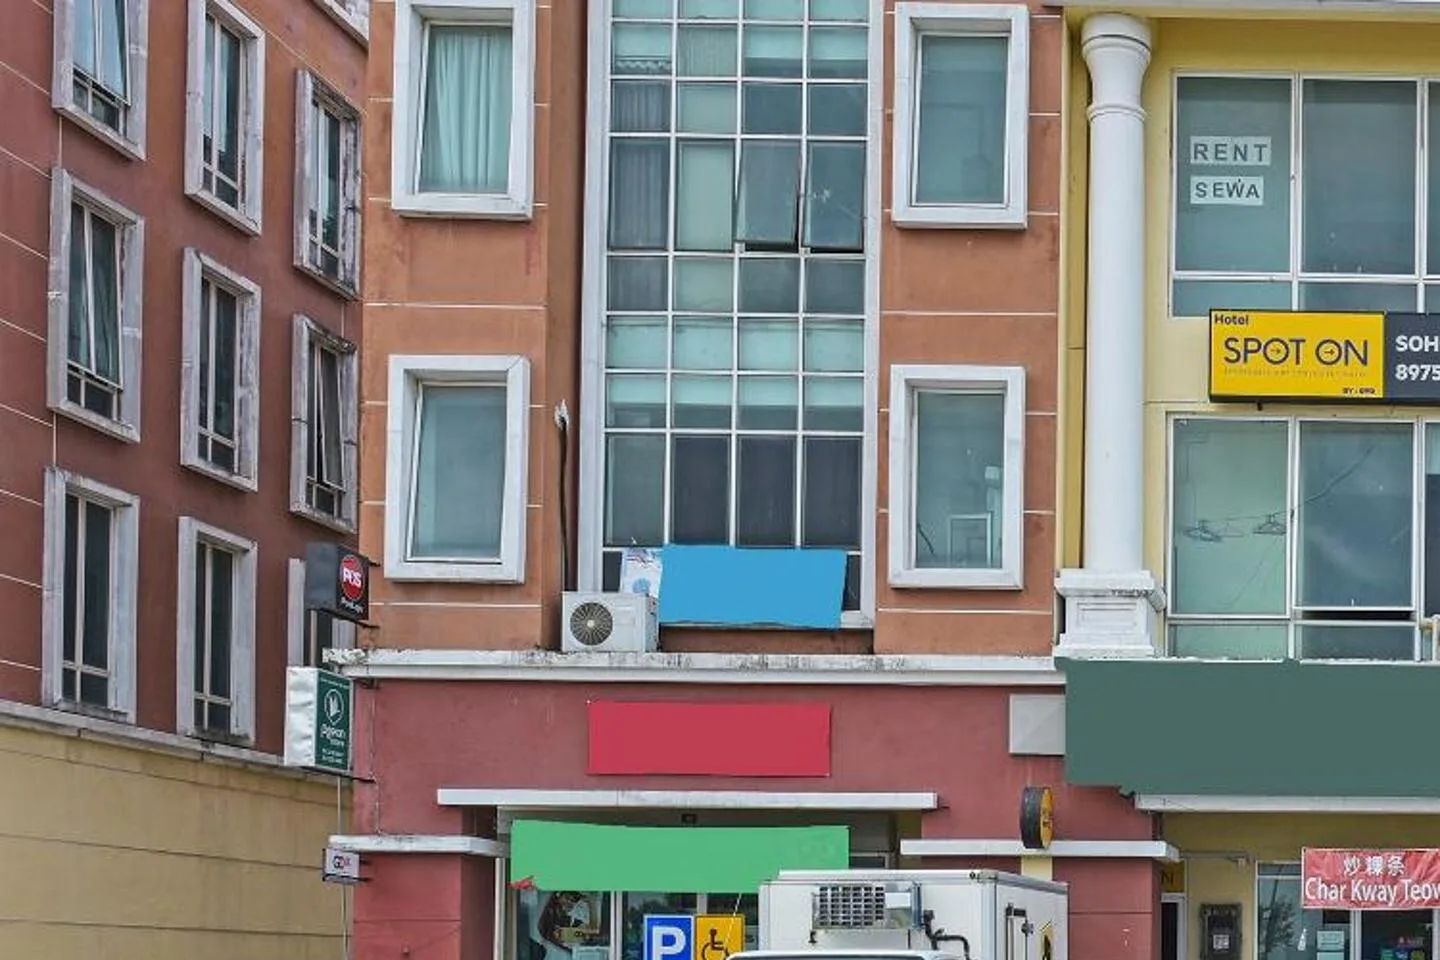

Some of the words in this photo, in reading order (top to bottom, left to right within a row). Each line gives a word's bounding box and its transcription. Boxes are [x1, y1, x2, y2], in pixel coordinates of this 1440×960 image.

[1193, 143, 1268, 162] RENT
[1195, 181, 1260, 199] SEWA
[1214, 313, 1249, 326] Hotel
[1223, 337, 1306, 366] SPOT
[1315, 339, 1369, 366] ON
[1305, 878, 1348, 900] Char
[1351, 879, 1398, 905] Kway
